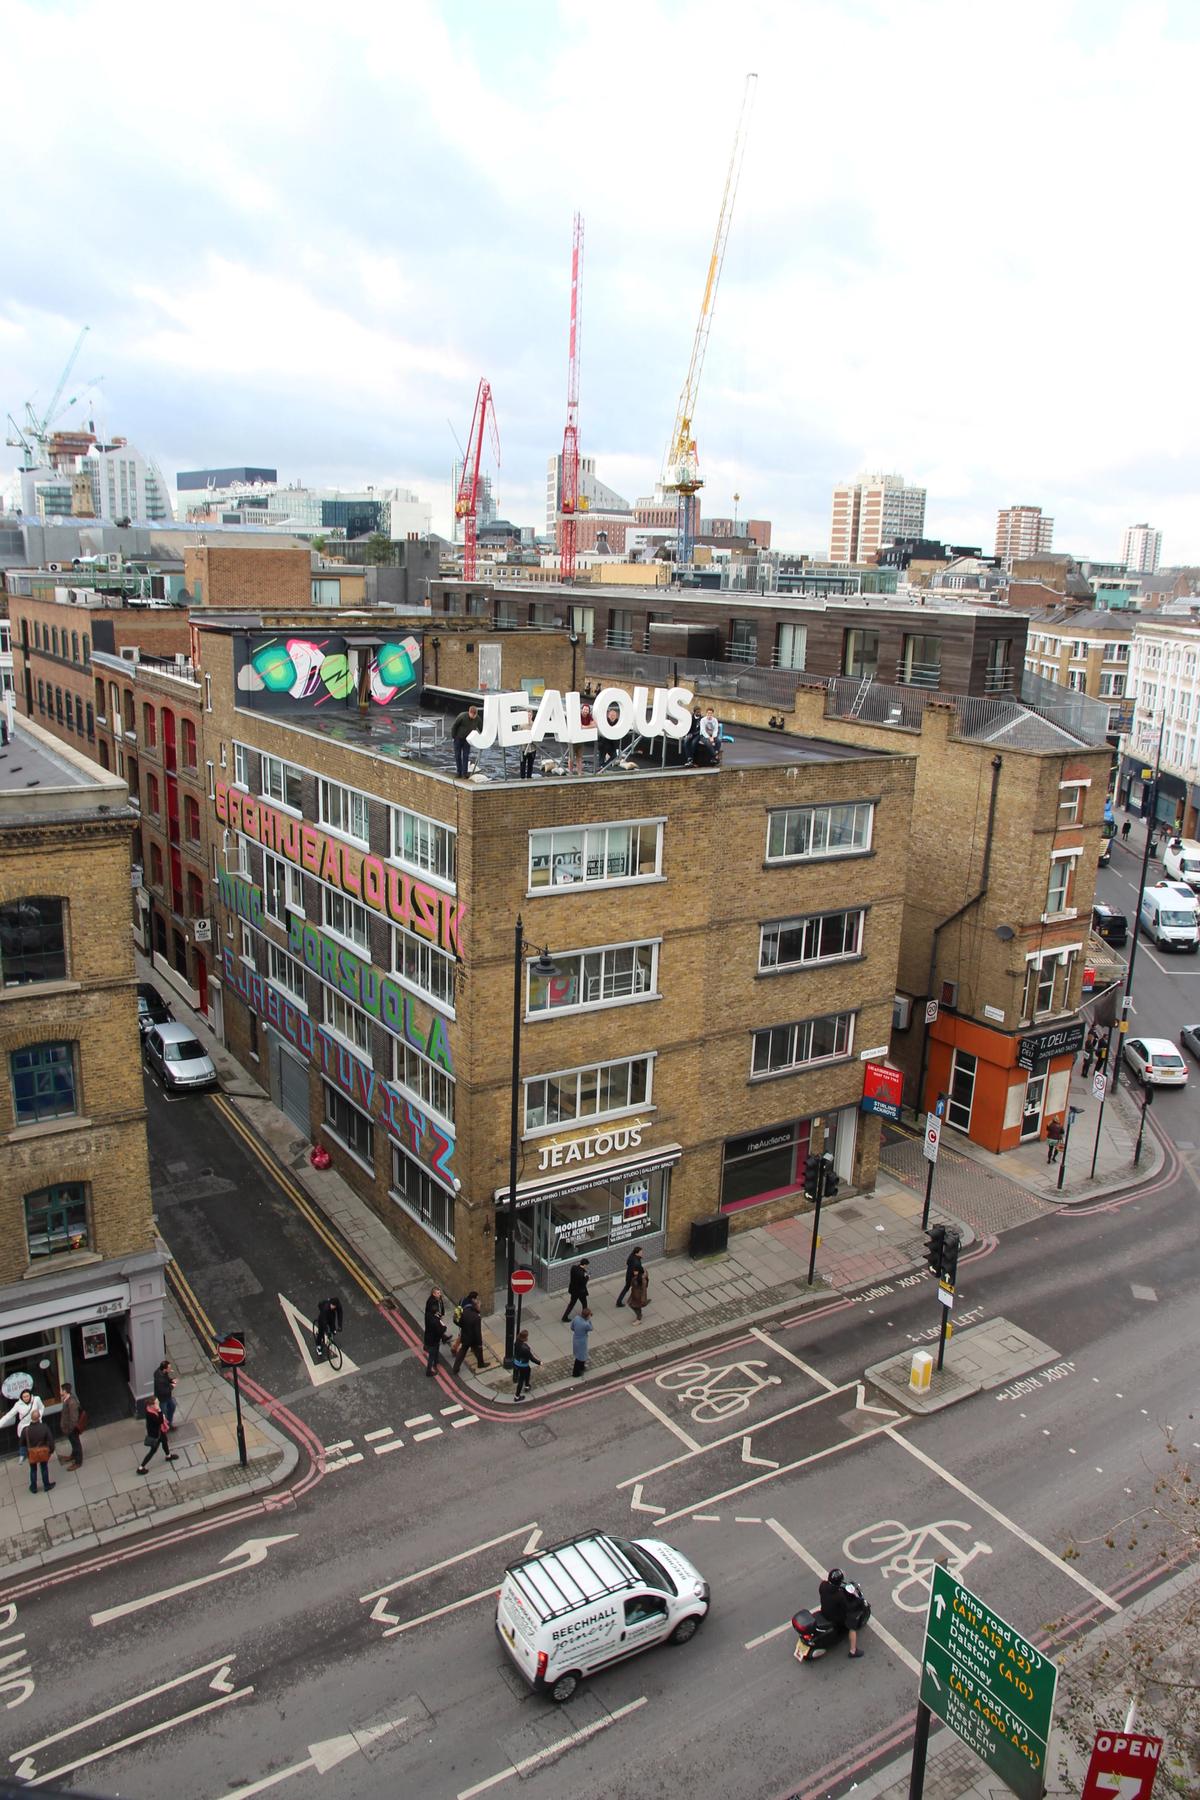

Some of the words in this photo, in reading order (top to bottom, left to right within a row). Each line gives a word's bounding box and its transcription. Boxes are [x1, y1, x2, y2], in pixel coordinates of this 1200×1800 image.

[466, 687, 693, 749] JEALOUS
[1047, 1032, 1067, 1047] DELI
[873, 1106, 896, 1117] ACKROYD
[874, 1101, 896, 1112] STIRLING
[538, 1128, 642, 1170] JEALOUS
[531, 1192, 558, 1204] PUBLISHING
[561, 1185, 588, 1196] SILKSCREEN
[593, 1178, 609, 1187] DIGITAL
[610, 1175, 623, 1183] PRINT
[623, 1170, 639, 1179] STUDIO
[642, 1165, 660, 1174] GALLERY
[555, 1221, 577, 1234] MOON
[578, 1215, 600, 1227] DAZED
[861, 1285, 894, 1302] RIGHT
[896, 1272, 928, 1288] LOOK
[920, 1324, 942, 1339] LOO
[951, 1309, 984, 1326] LEFT
[1004, 1377, 1043, 1400] RIGHT
[1039, 1362, 1075, 1382] LOOK
[552, 1607, 617, 1641] BEECHHALL
[951, 1613, 996, 1660] Hertford
[954, 1586, 983, 1619] (Ring
[986, 1616, 1011, 1642] road
[1014, 1639, 1042, 1669] (S))
[948, 1640, 992, 1685] Hackney
[950, 1626, 990, 1667] Dalston
[948, 1688, 966, 1711] The
[969, 1709, 990, 1735] City
[951, 1663, 974, 1691] Ring
[977, 1689, 1001, 1716] road
[1005, 1713, 1028, 1740] (W)
[946, 1711, 987, 1758] Holborn
[947, 1699, 972, 1731] West
[976, 1730, 996, 1754] End
[1097, 1736, 1159, 1759] OPEN
